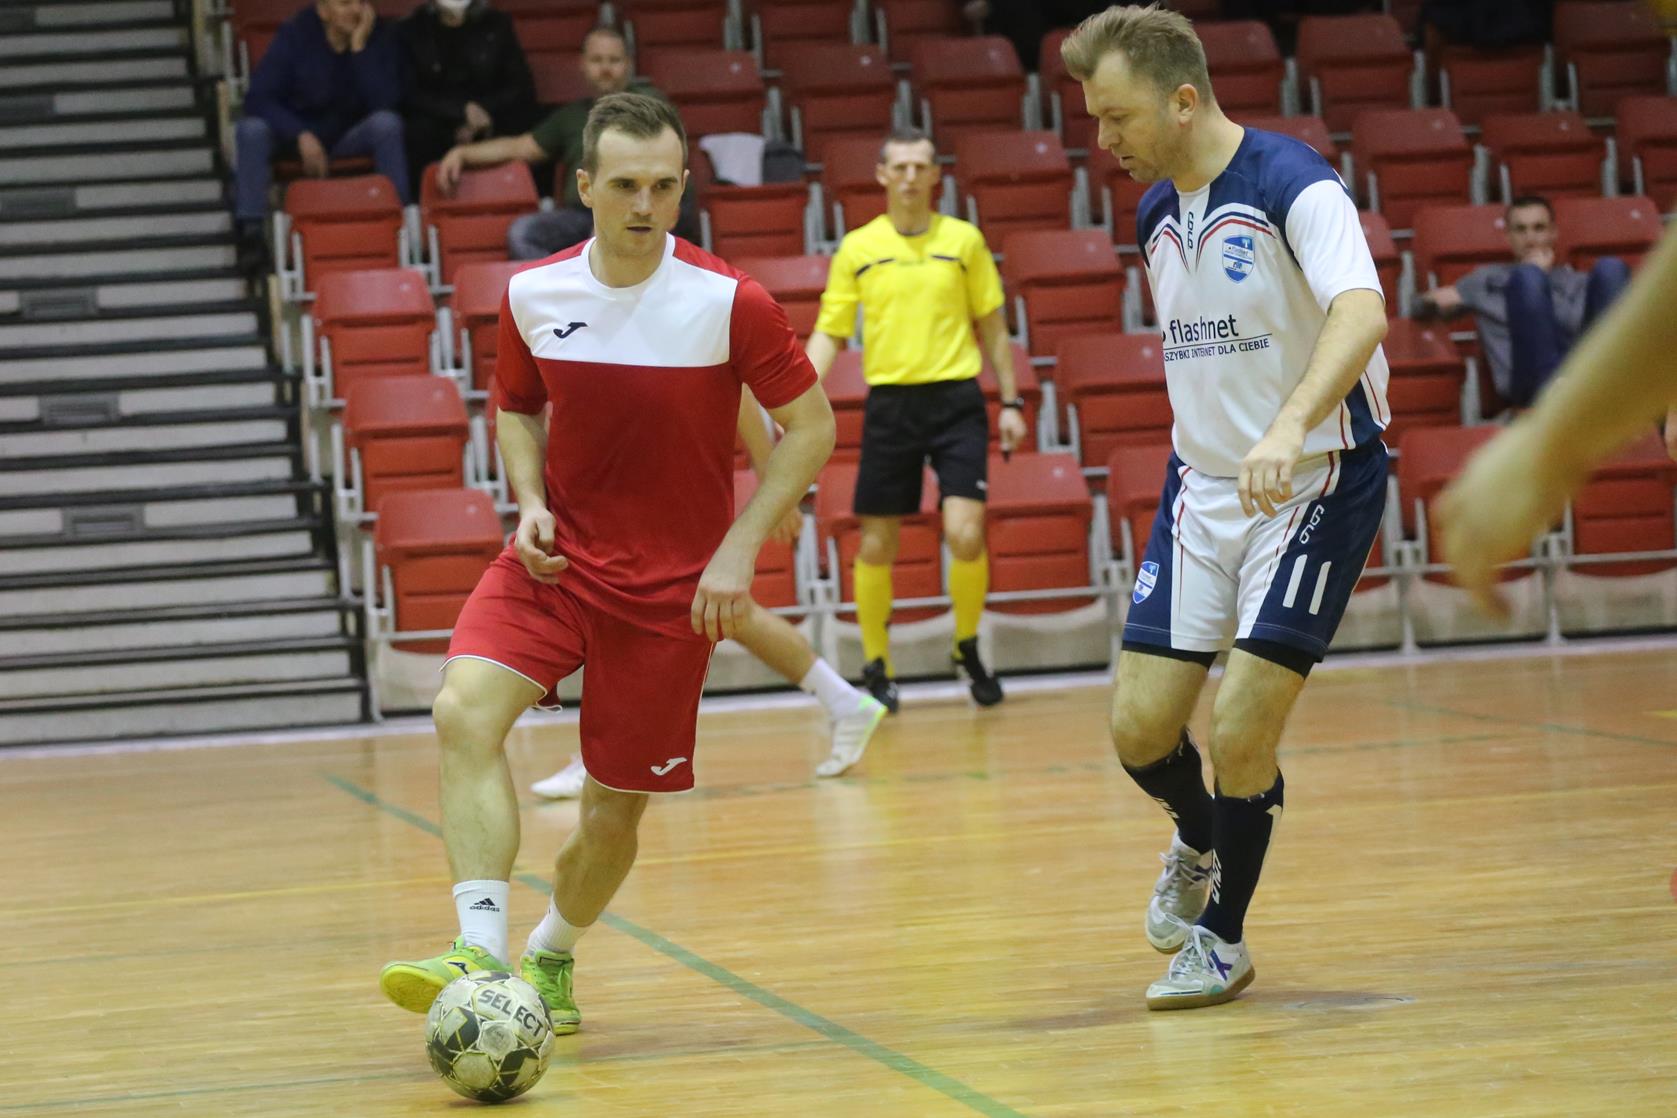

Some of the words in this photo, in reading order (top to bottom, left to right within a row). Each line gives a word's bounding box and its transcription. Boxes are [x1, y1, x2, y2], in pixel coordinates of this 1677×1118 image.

[1169, 314, 1239, 345] flashnet
[1164, 349, 1190, 362] SZYBKI
[1218, 343, 1237, 355] DLA
[1238, 338, 1270, 352] CIEBIE
[1282, 554, 1332, 615] 11
[469, 905, 501, 913] adidas
[478, 989, 544, 1037] SELECT
